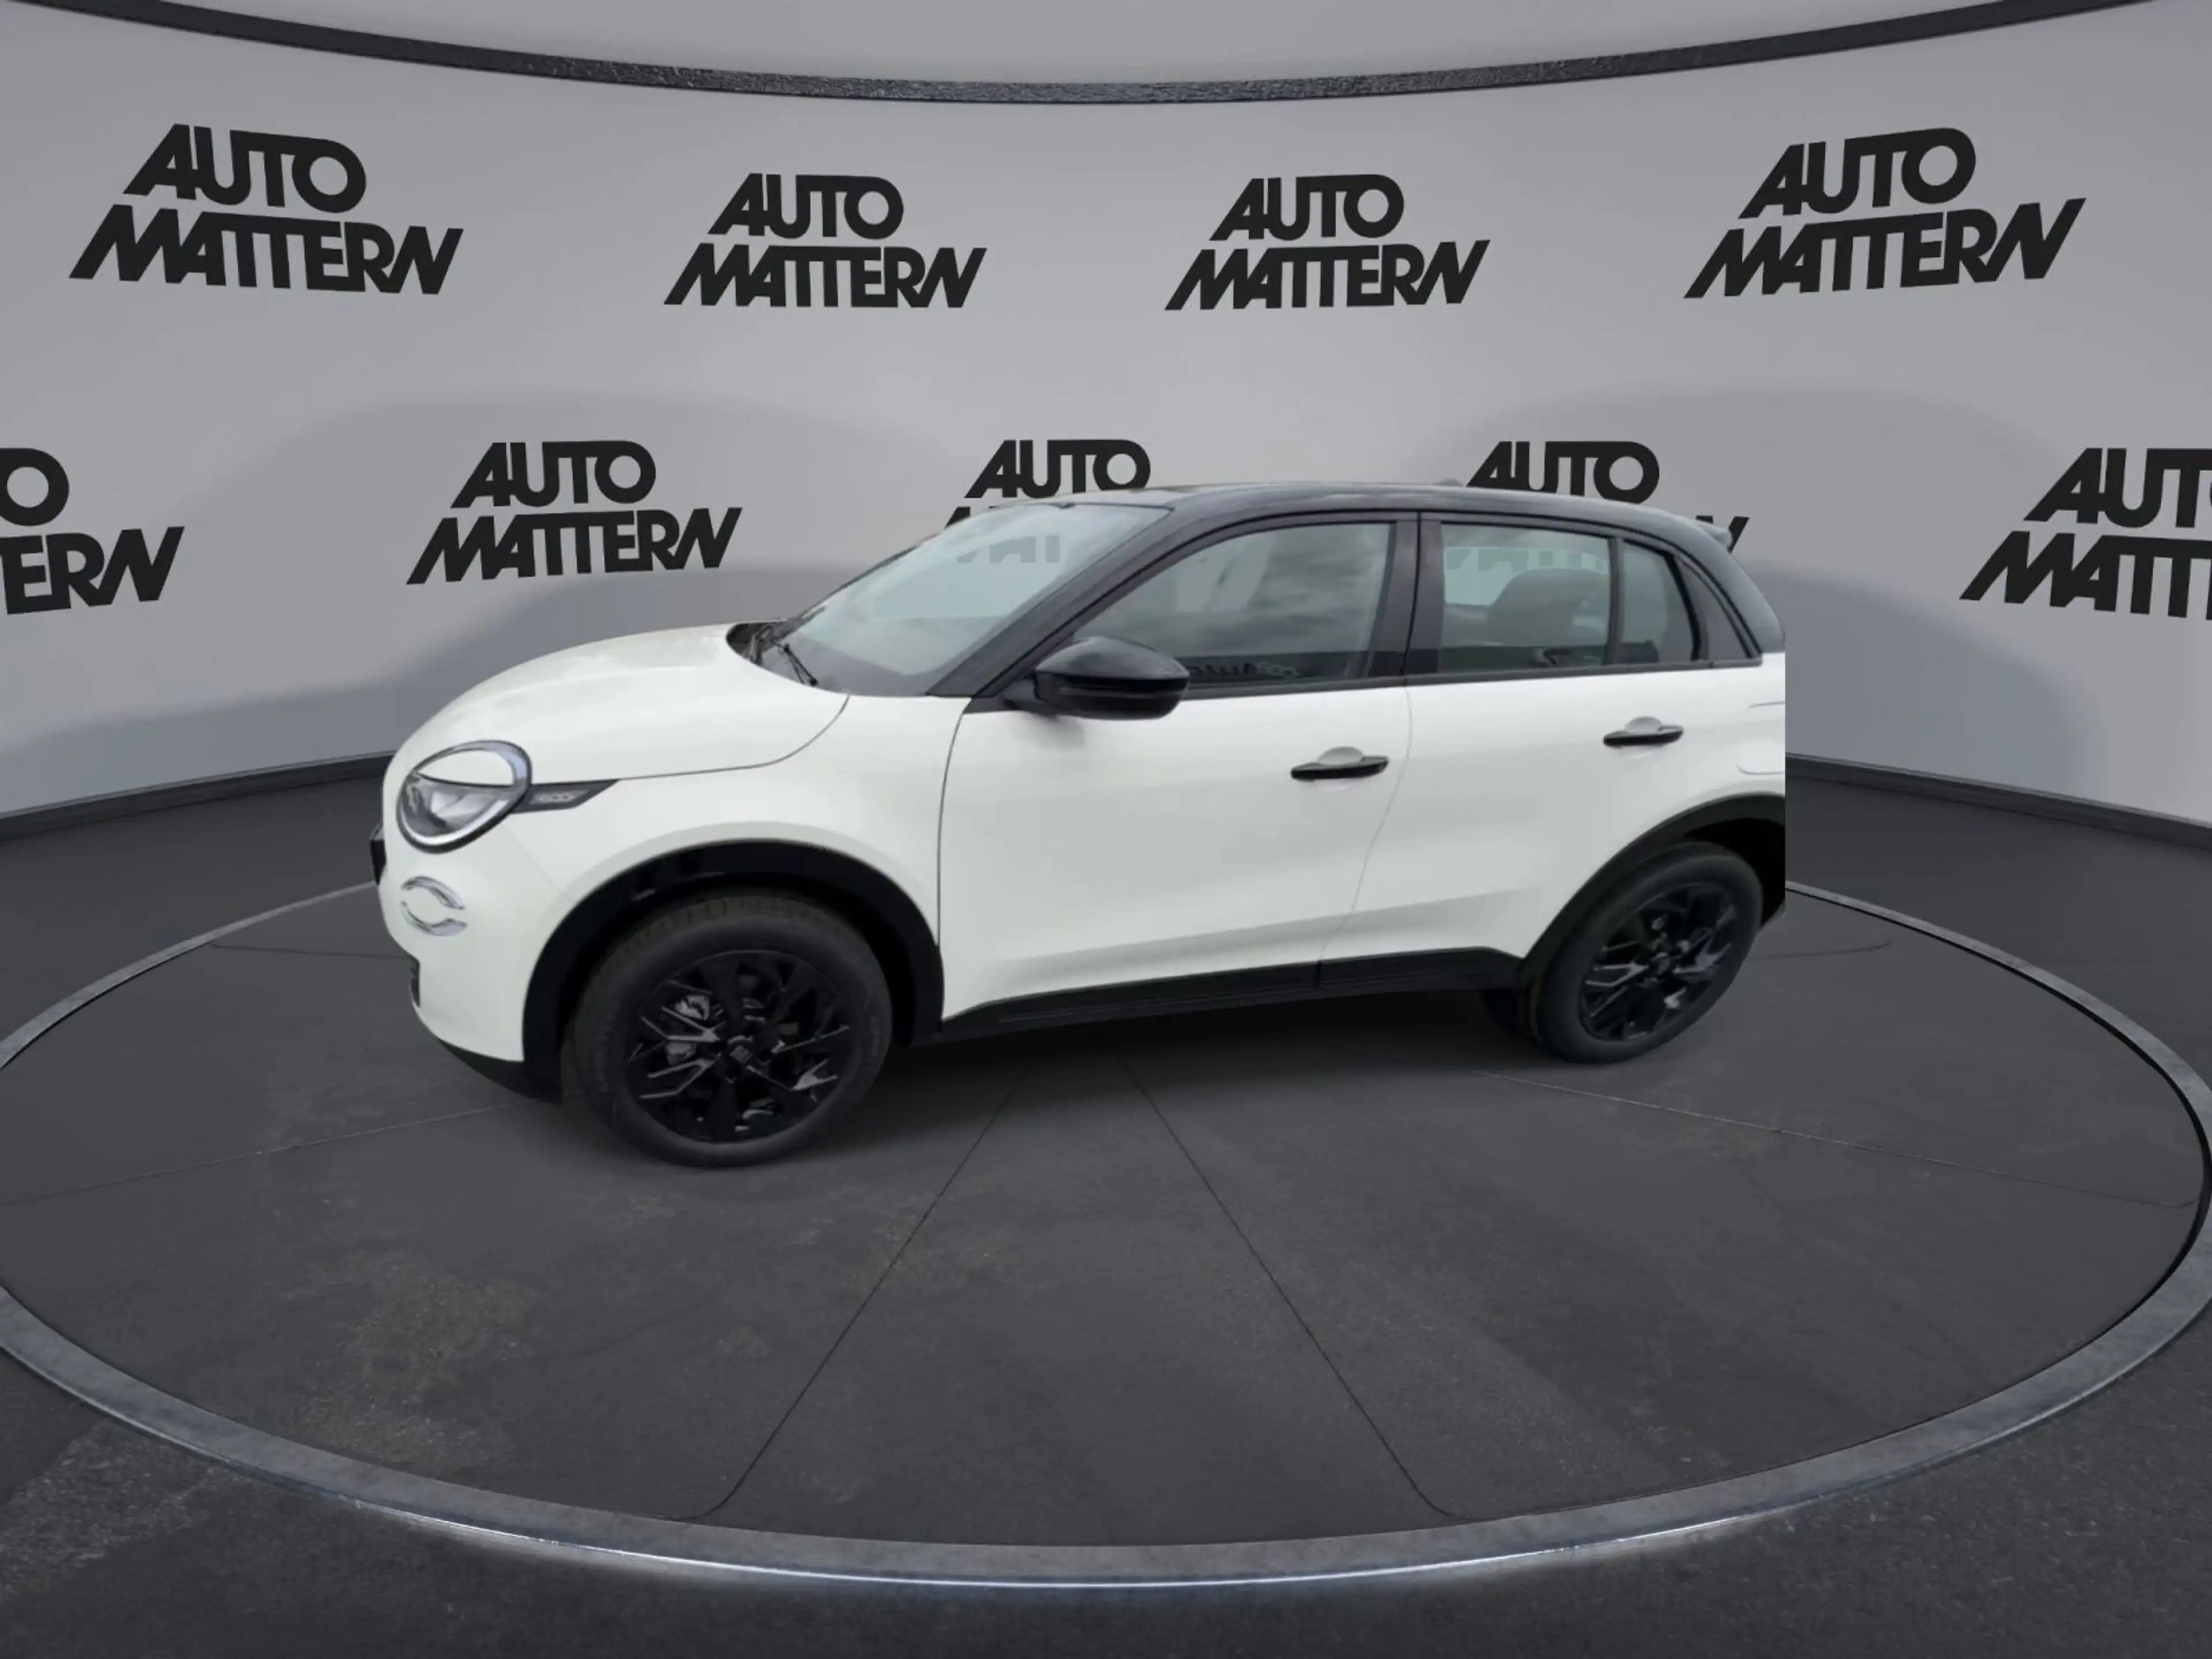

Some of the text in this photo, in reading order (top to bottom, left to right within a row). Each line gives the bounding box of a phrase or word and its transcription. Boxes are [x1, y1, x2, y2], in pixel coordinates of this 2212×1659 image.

[123, 124, 366, 213] AUTO
[1738, 128, 1976, 219] AUTO
[708, 173, 904, 240] AUTO
[1210, 174, 1404, 241] AUTO
[69, 204, 464, 294] MATTERN
[664, 243, 987, 308] MATTERN
[1165, 239, 1490, 310] MATTERN
[1683, 198, 2086, 298] MATTERN
[450, 441, 656, 509] AUTO
[964, 440, 1151, 499] AUTO
[1467, 441, 1660, 504] AUTO
[2024, 448, 2212, 528] AUT
[406, 507, 742, 585] MATTERN
[1959, 531, 2212, 620] MATT
